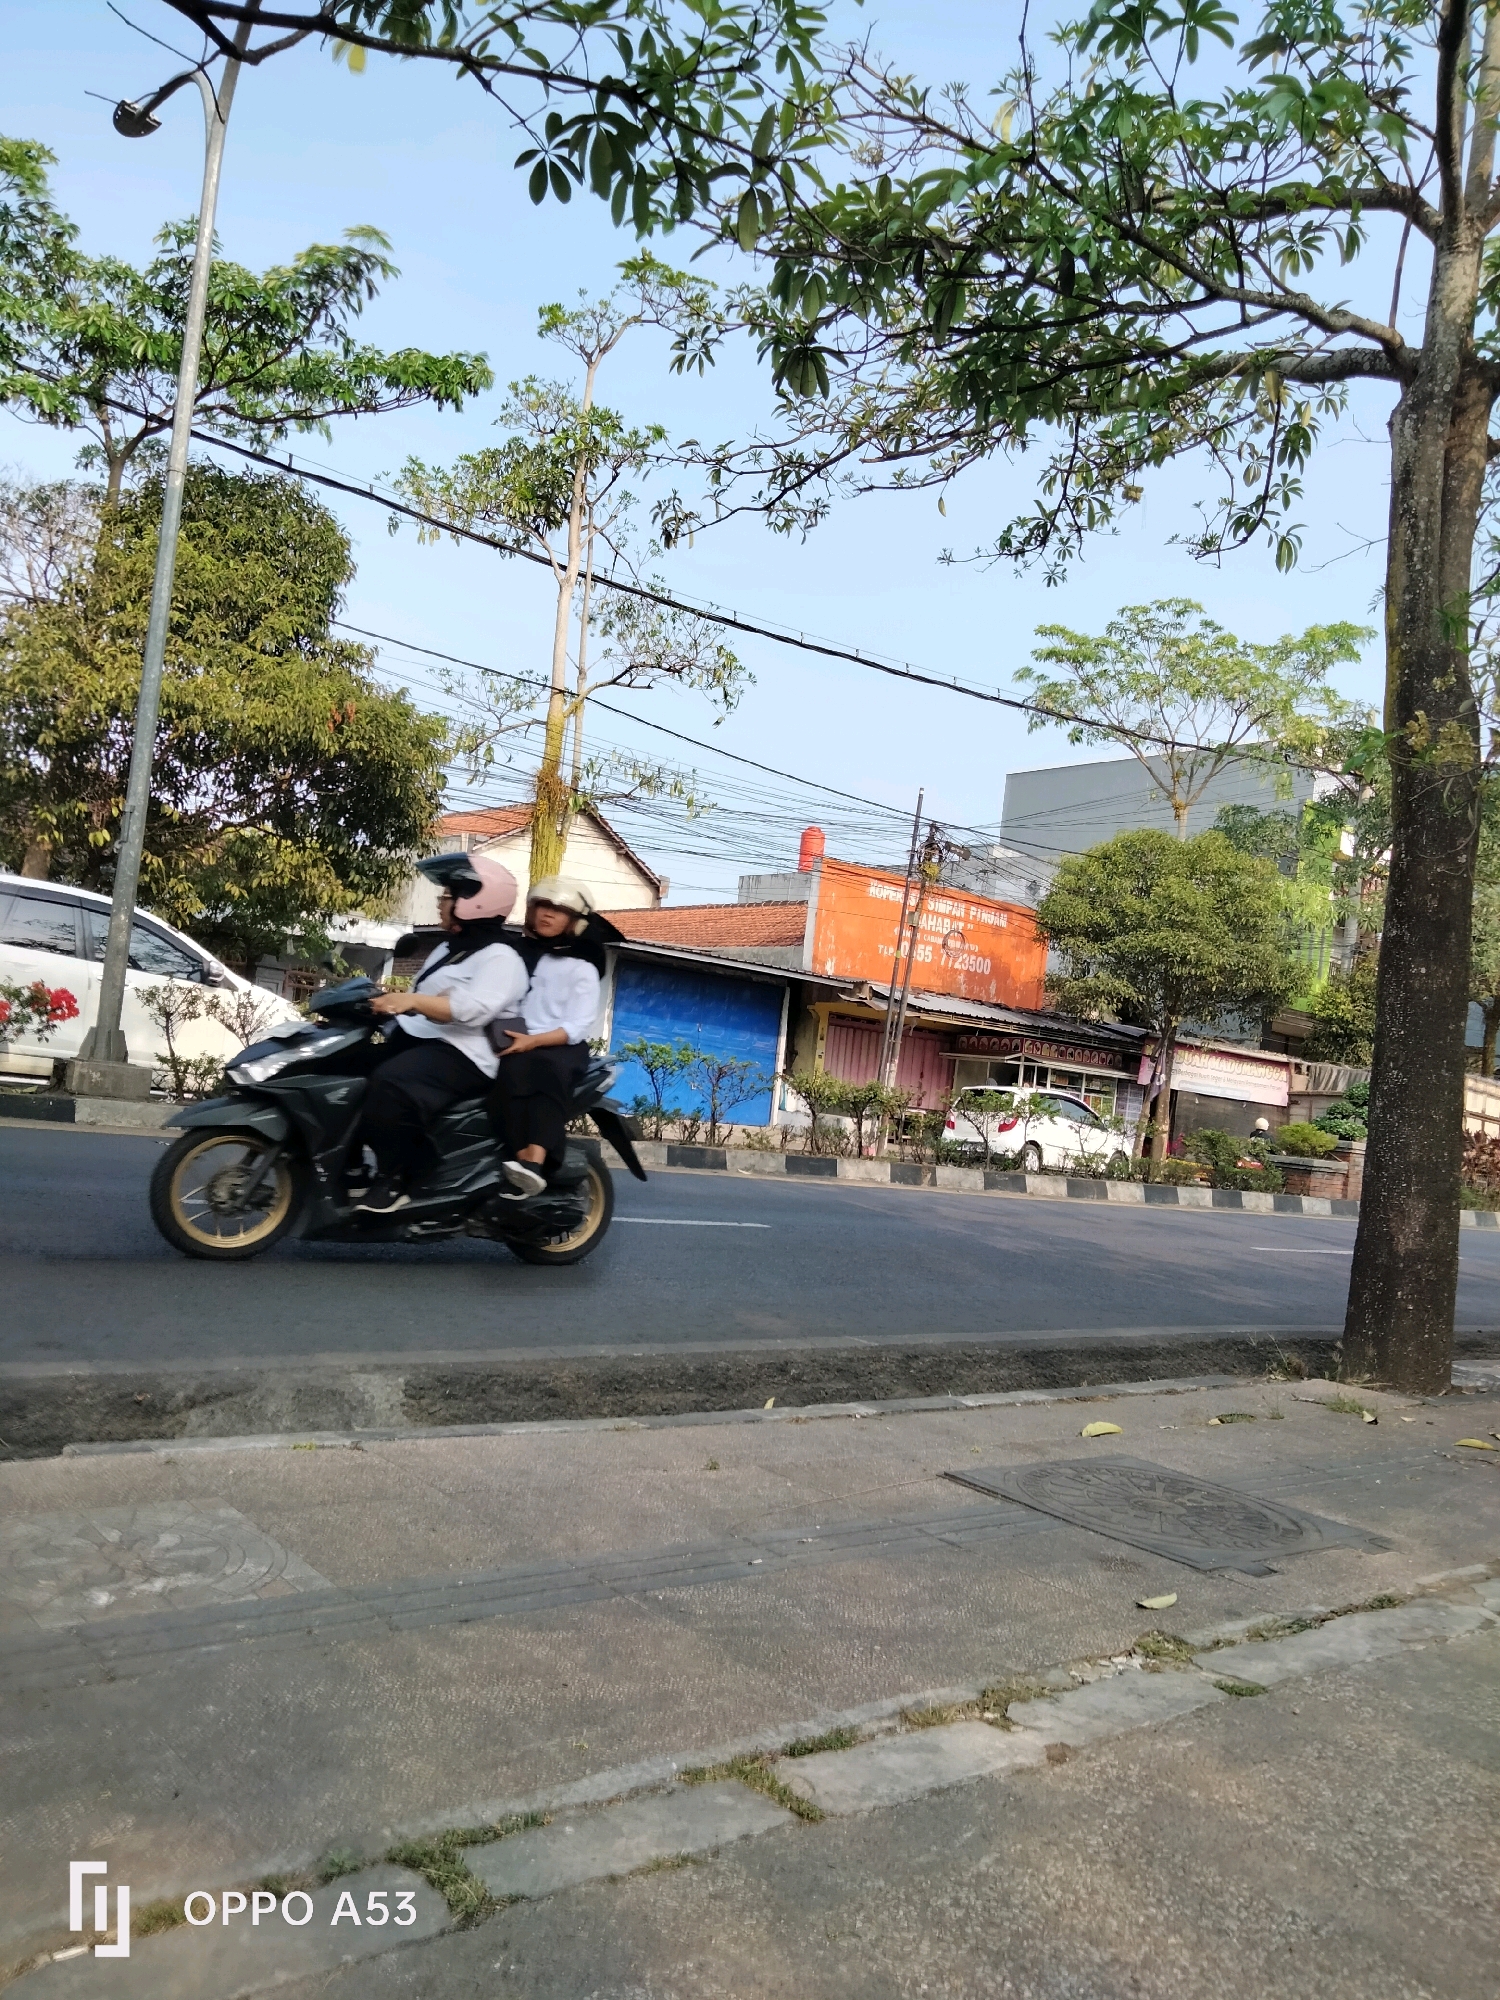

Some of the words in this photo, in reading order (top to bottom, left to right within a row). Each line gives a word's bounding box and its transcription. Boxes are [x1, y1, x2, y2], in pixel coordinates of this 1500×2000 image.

[927, 897, 965, 917] SIMPAN
[969, 905, 1008, 928] PINJAM
[1175, 1050, 1209, 1069] BUAH
